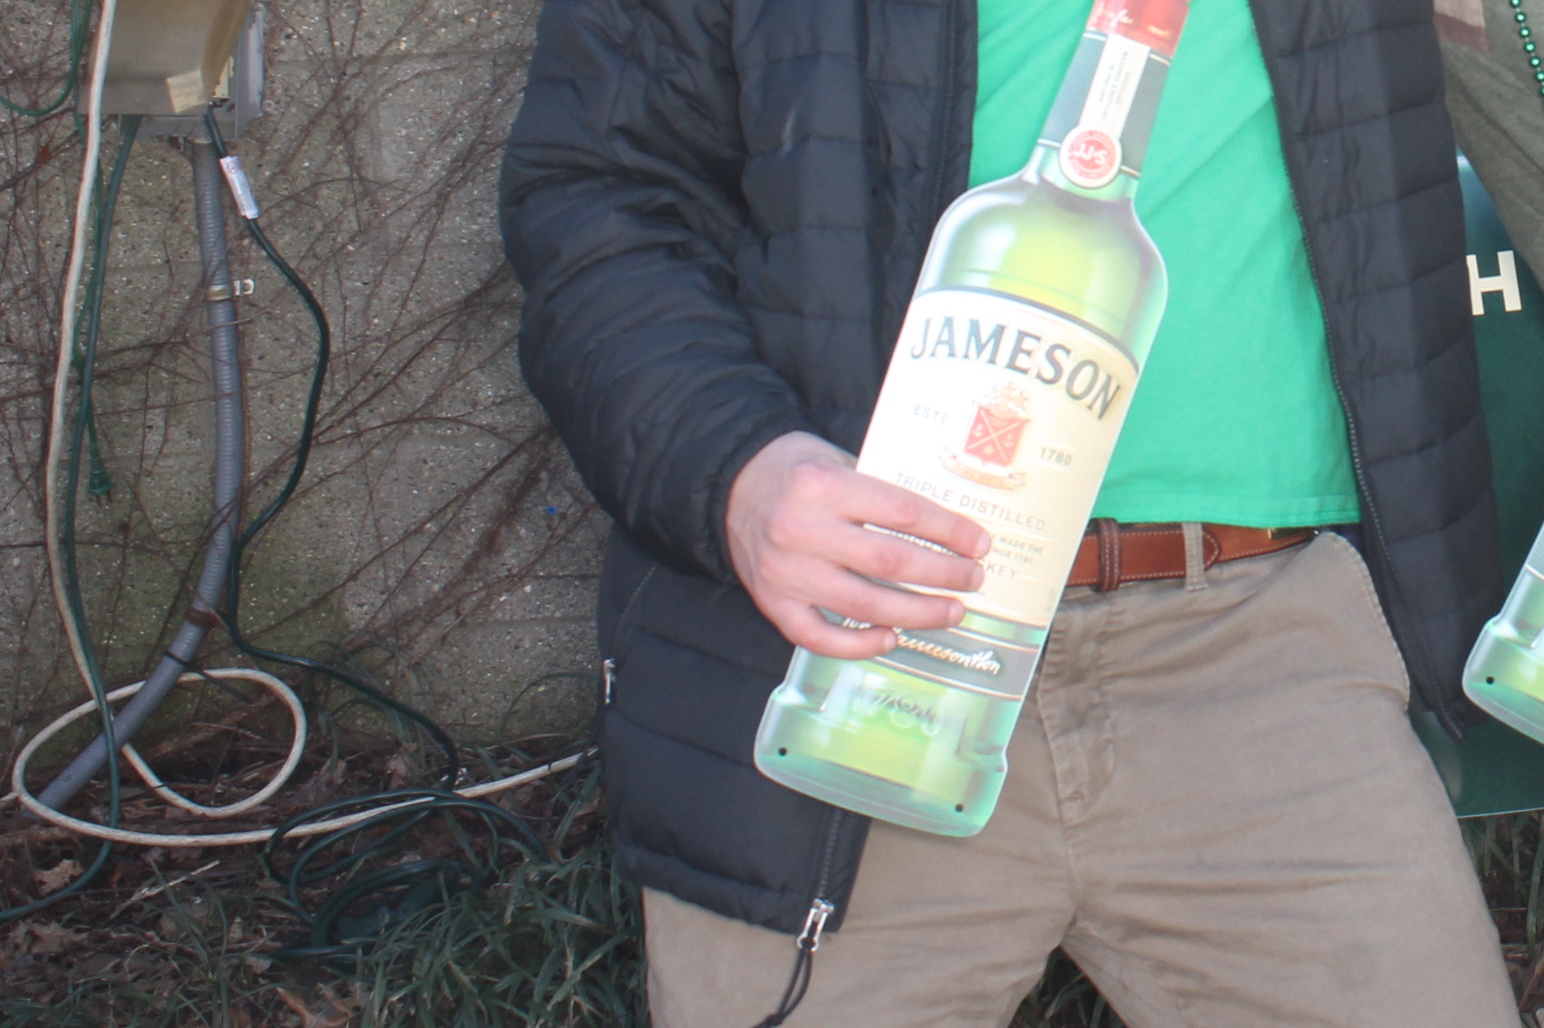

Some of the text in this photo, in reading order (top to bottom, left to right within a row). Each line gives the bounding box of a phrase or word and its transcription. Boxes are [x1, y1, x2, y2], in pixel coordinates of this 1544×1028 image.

[910, 316, 1121, 421] JAMESON
[1040, 447, 1073, 466] 1780
[896, 472, 954, 503] TRIPLE
[958, 494, 1046, 532] DISTILLED
[1000, 536, 1027, 551] MADE
